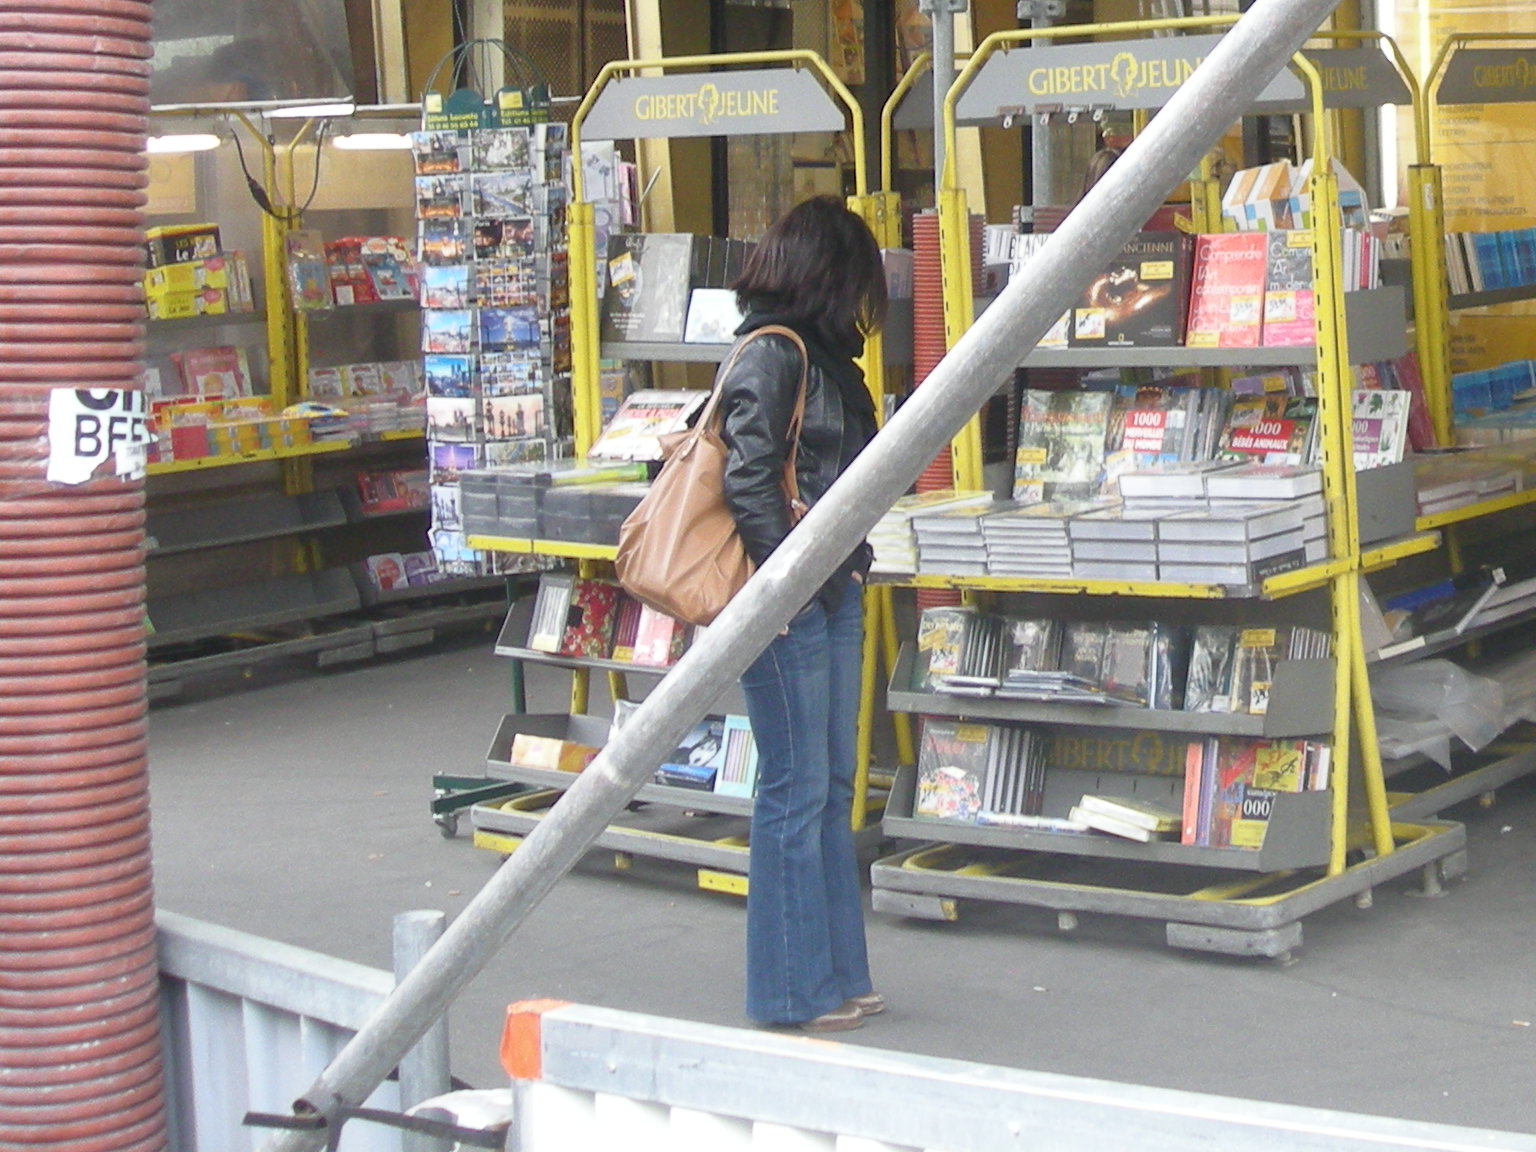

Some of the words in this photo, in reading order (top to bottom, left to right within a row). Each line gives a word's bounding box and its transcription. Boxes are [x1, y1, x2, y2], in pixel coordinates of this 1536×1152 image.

[1027, 63, 1110, 96] GIBERT
[1322, 65, 1369, 91] JEUNE
[634, 93, 698, 120] GIBERT
[717, 88, 779, 116] JEUNE
[1133, 412, 1161, 426] 1000
